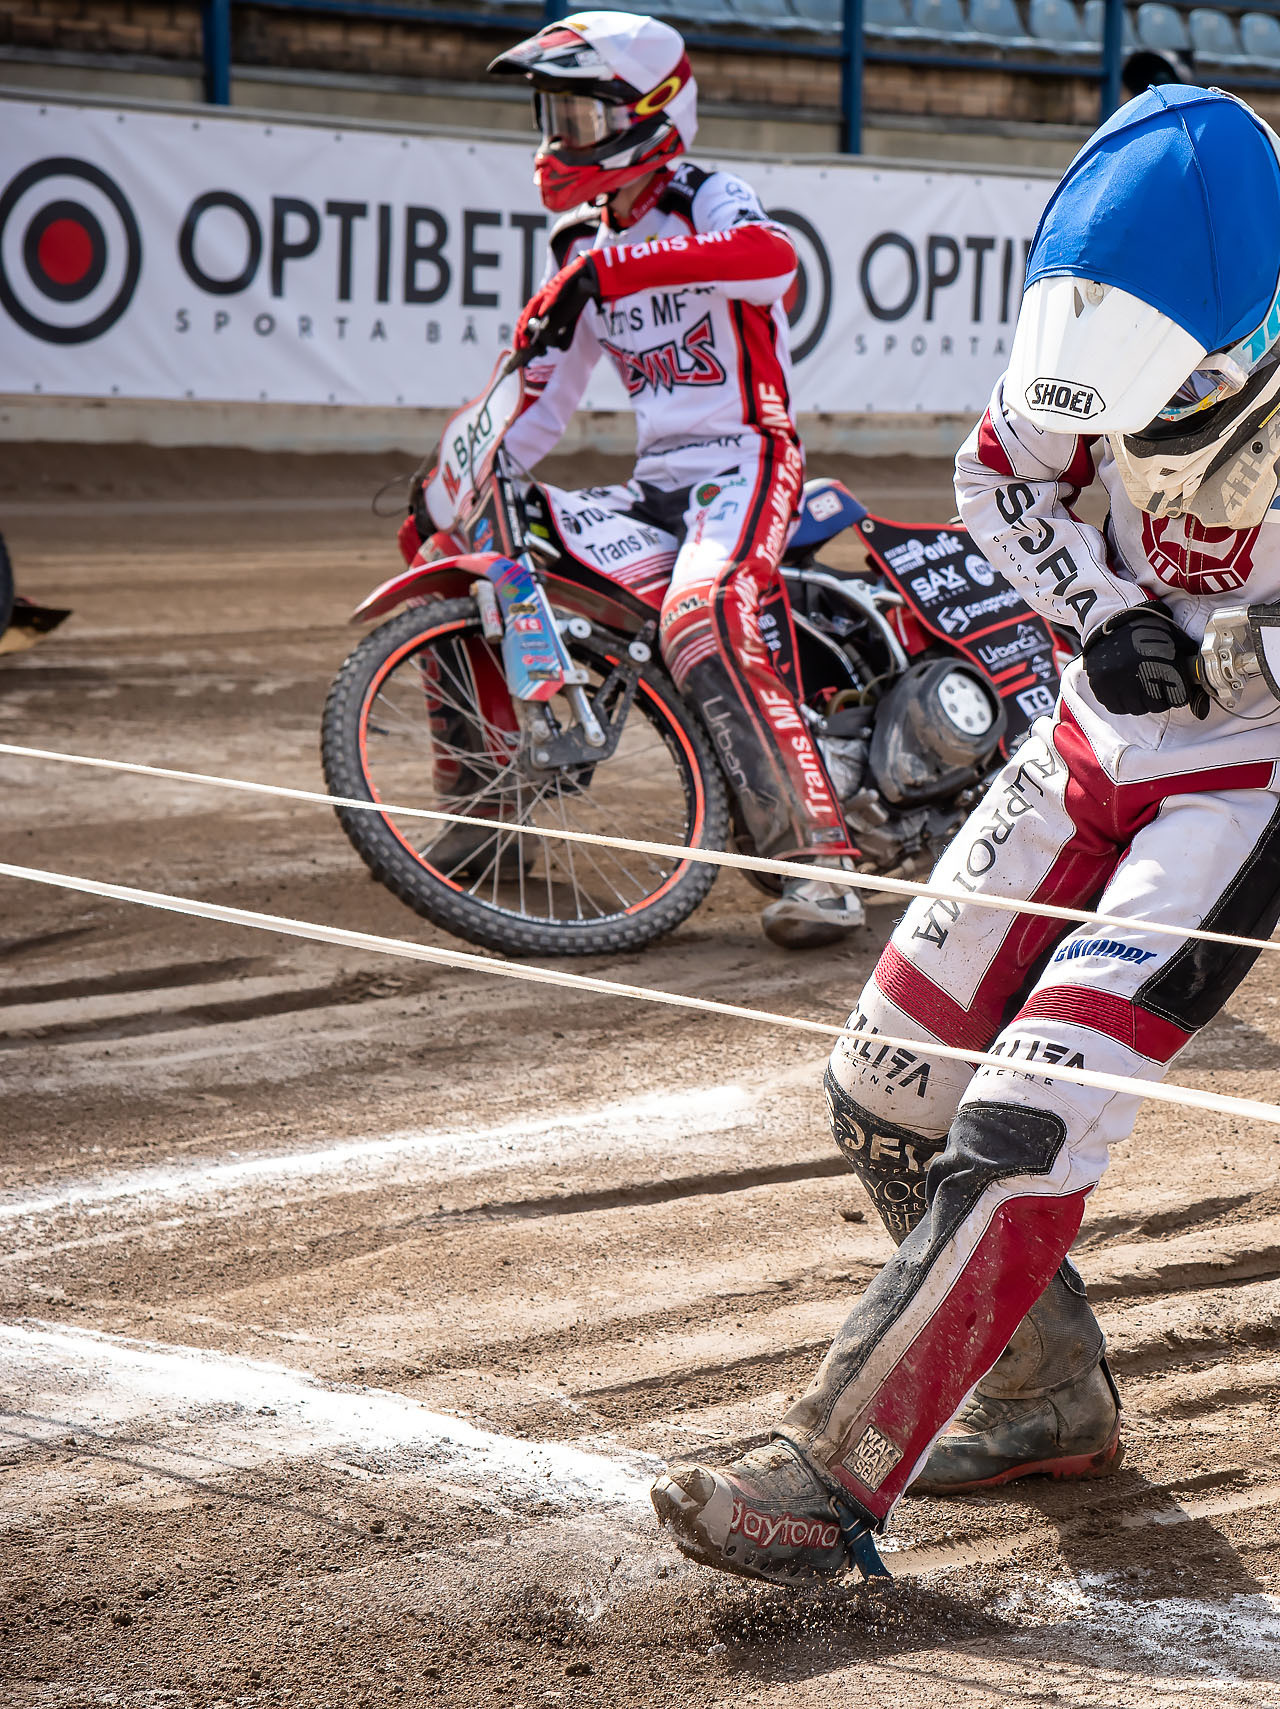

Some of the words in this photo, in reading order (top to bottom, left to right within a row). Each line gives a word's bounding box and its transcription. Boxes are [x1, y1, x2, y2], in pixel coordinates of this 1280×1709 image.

[179, 189, 548, 308] OPTIBET
[602, 235, 689, 268] Trans
[859, 231, 1031, 324] OPTI
[175, 308, 387, 342] SPORTA
[426, 314, 513, 346] BĀR
[854, 333, 1006, 356] SPORTA
[758, 382, 791, 429] MF
[1031, 383, 1095, 416] SHOEI
[585, 534, 642, 567] Trans
[994, 482, 1098, 627] SOFIA
[911, 563, 967, 601] SAX
[760, 689, 802, 730] MF
[792, 735, 833, 818] Trans
